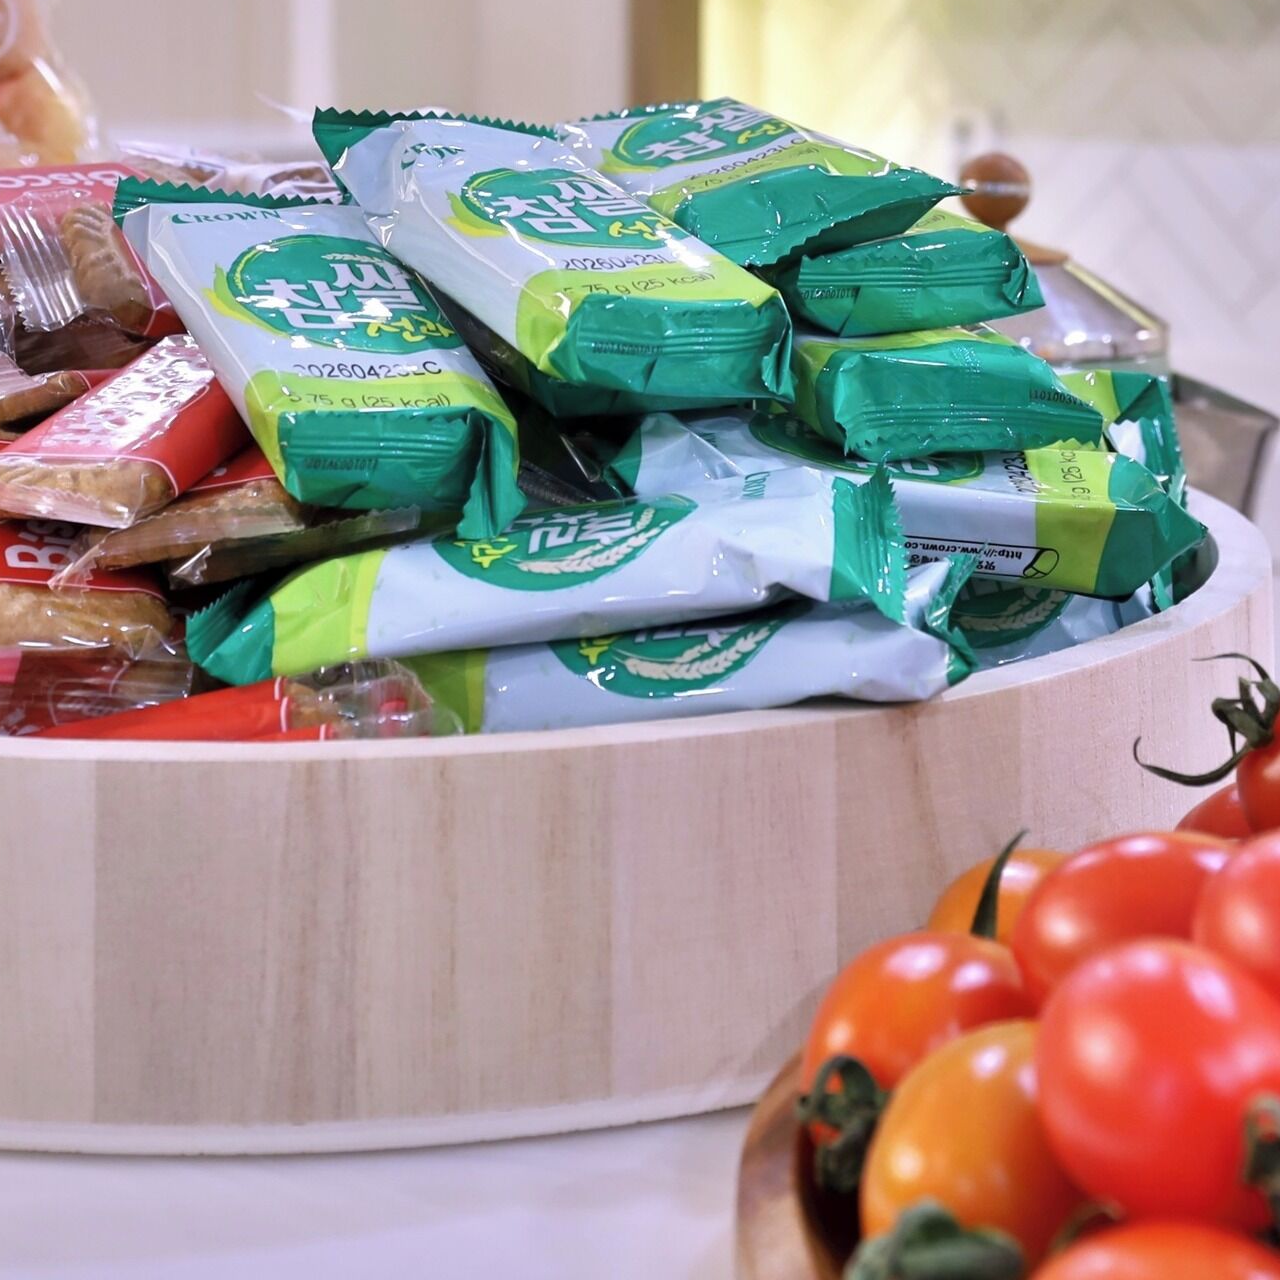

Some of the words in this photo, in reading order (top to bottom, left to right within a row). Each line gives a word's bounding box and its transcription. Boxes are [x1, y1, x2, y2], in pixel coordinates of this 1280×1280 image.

[490, 181, 652, 234] 참쌀
[171, 209, 282, 225] CROWN
[563, 253, 678, 271] 20260423L
[253, 263, 427, 330] 참쌀
[340, 397, 356, 409] g
[361, 394, 395, 409] (25
[400, 391, 451, 408] kcal)
